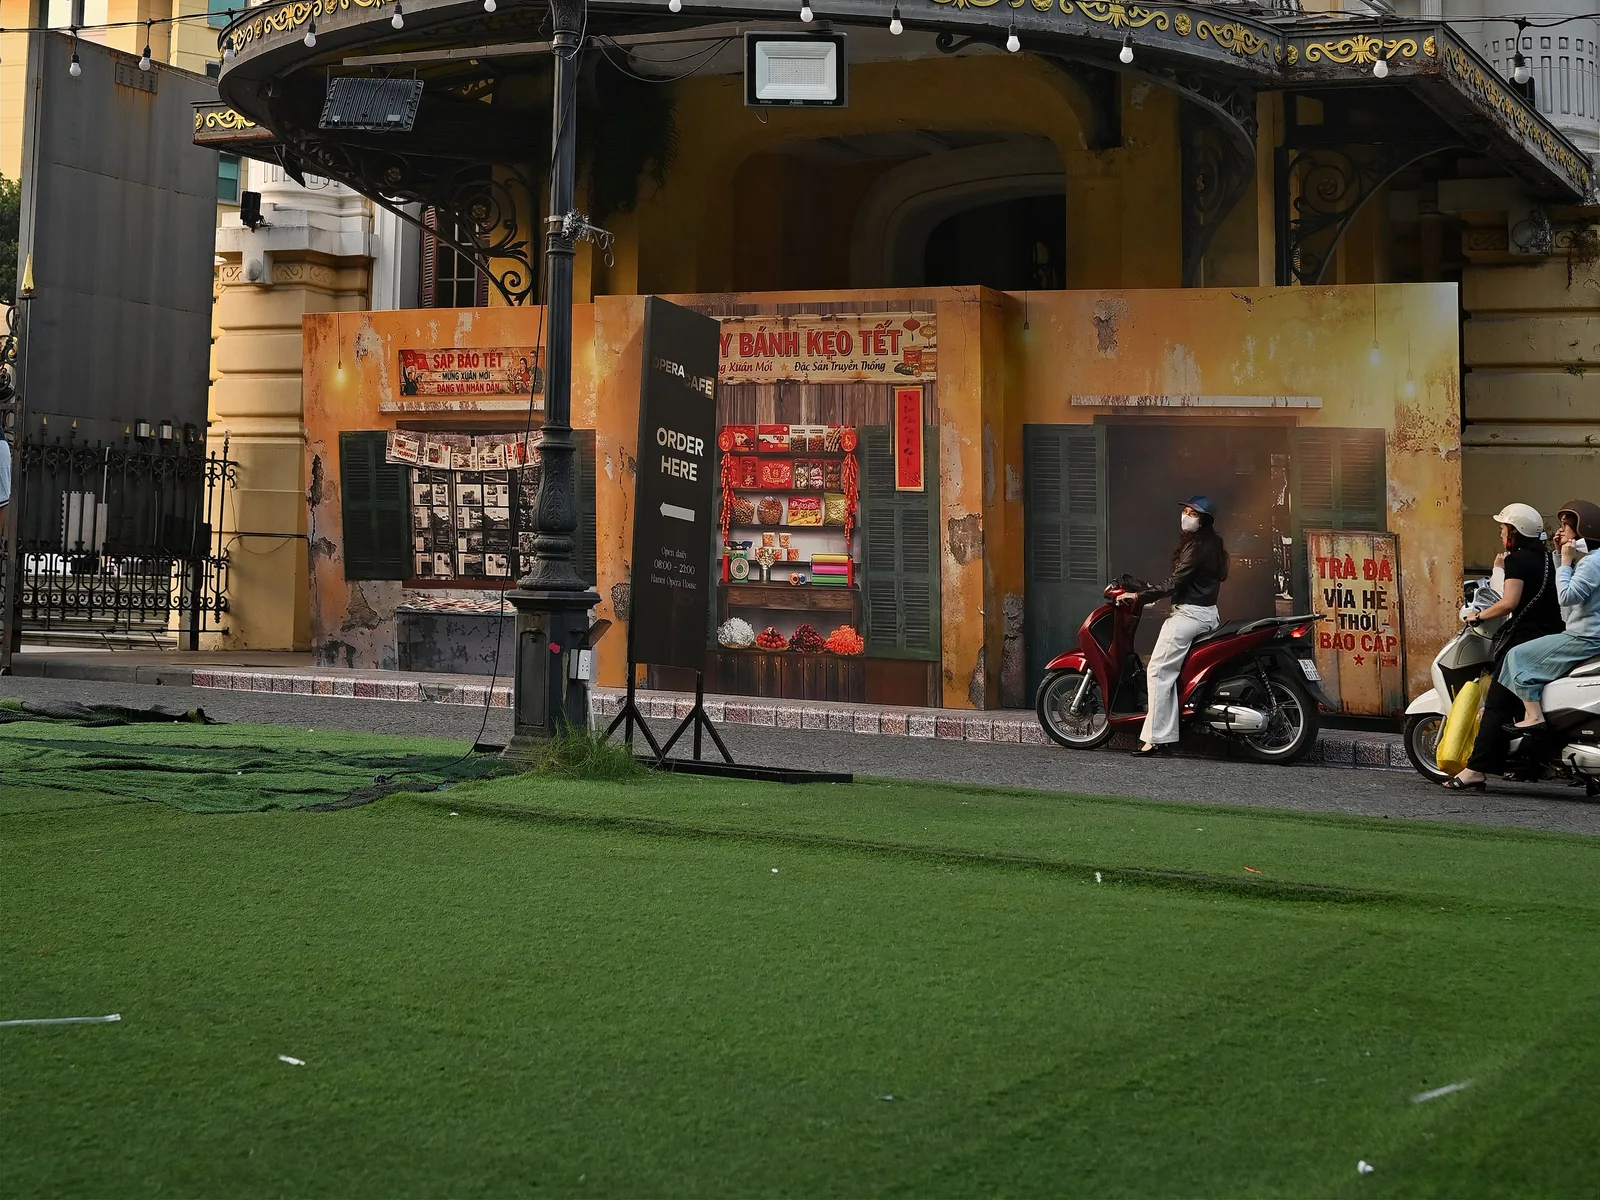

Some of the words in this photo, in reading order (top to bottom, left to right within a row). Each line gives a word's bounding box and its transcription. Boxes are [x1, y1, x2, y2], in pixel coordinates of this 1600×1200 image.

[739, 325, 800, 357] BÁNH
[806, 329, 853, 361] KẸO
[859, 319, 903, 356] TẾT
[433, 353, 454, 371] SẠP
[457, 350, 480, 368] BÁO
[482, 348, 504, 368] TẾT
[653, 356, 685, 378] OPERA
[729, 361, 753, 372] Xuân
[755, 359, 773, 372] Mới
[794, 361, 811, 372] Đặc
[683, 373, 713, 395] CAFE
[656, 427, 704, 457] ORDER
[661, 455, 698, 482] HERE
[1316, 553, 1358, 580] TRÀ
[1363, 554, 1393, 582] ĐÁ
[1323, 583, 1356, 608] VỈA
[1362, 586, 1388, 610] HÈ
[1337, 611, 1376, 631] THỜI
[1320, 632, 1356, 651] BAO
[1361, 629, 1397, 652] CẤP
